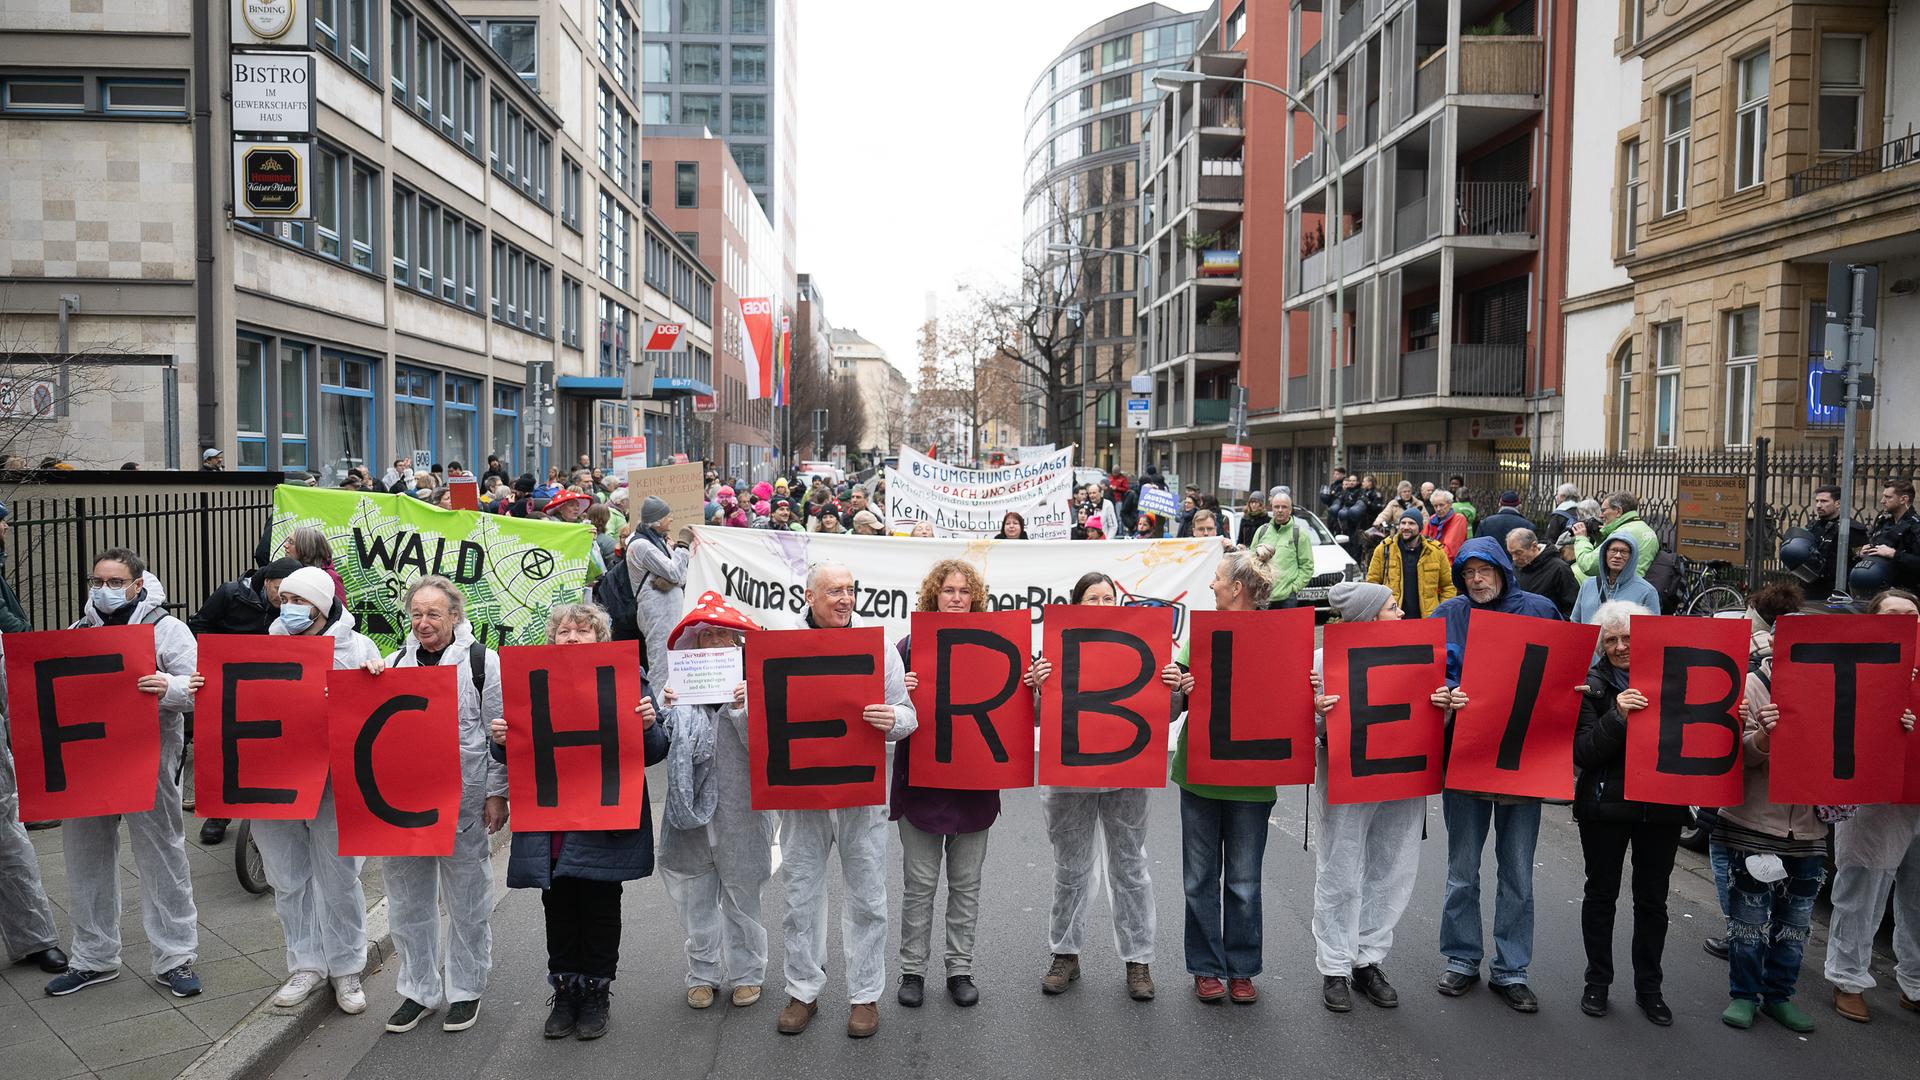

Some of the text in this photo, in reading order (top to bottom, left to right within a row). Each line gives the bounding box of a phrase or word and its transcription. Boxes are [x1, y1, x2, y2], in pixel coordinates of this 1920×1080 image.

[249, 5, 285, 14] BINDING
[234, 64, 306, 84] BISTRO
[265, 88, 276, 97] IM
[234, 100, 307, 110] GEWERKSCHAFTS
[259, 113, 283, 122] HAUS
[657, 324, 680, 336] DGB
[892, 497, 928, 521] Kein
[1034, 502, 1067, 524] mehr
[1030, 526, 1067, 539] anderswo
[352, 527, 485, 585] WALD
[721, 563, 784, 612] Klima
[788, 580, 908, 619] stzen
